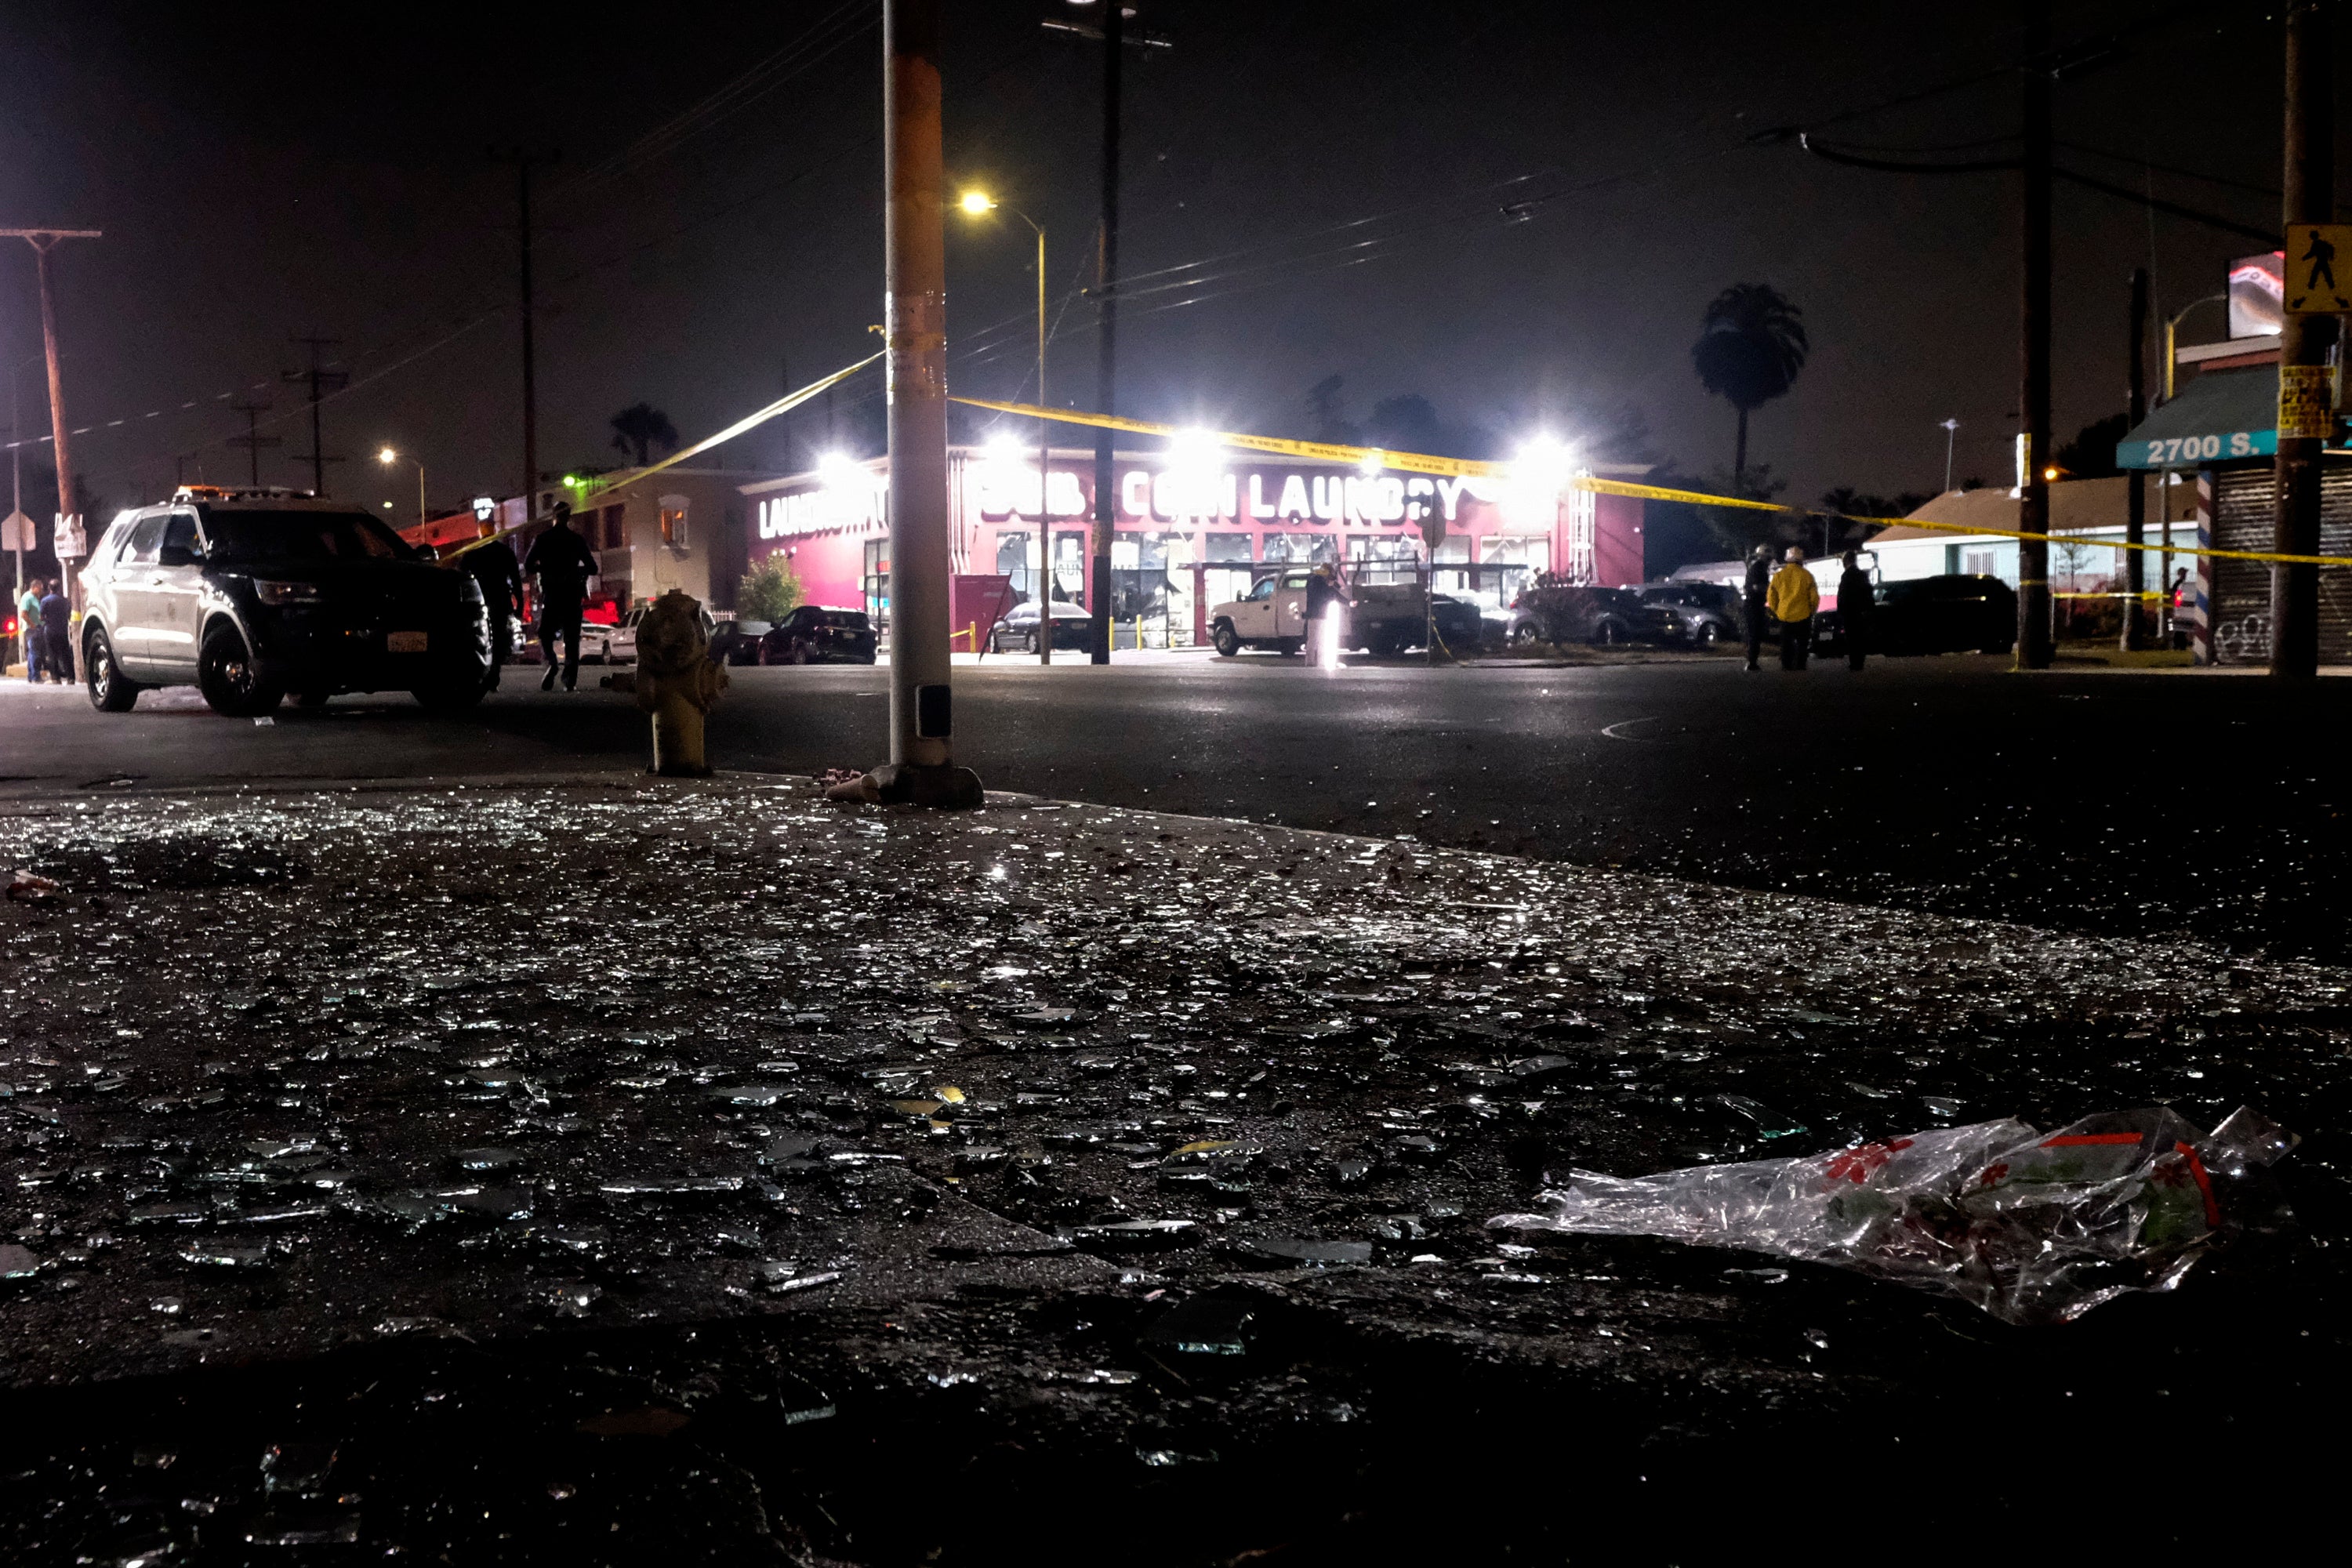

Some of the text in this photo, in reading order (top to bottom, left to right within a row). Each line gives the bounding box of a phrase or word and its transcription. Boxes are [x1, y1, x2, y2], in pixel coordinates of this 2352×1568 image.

[2147, 432, 2260, 463] 2700 S.
[1122, 470, 1236, 517] CON
[1250, 472, 1465, 521] LAUNDRY
